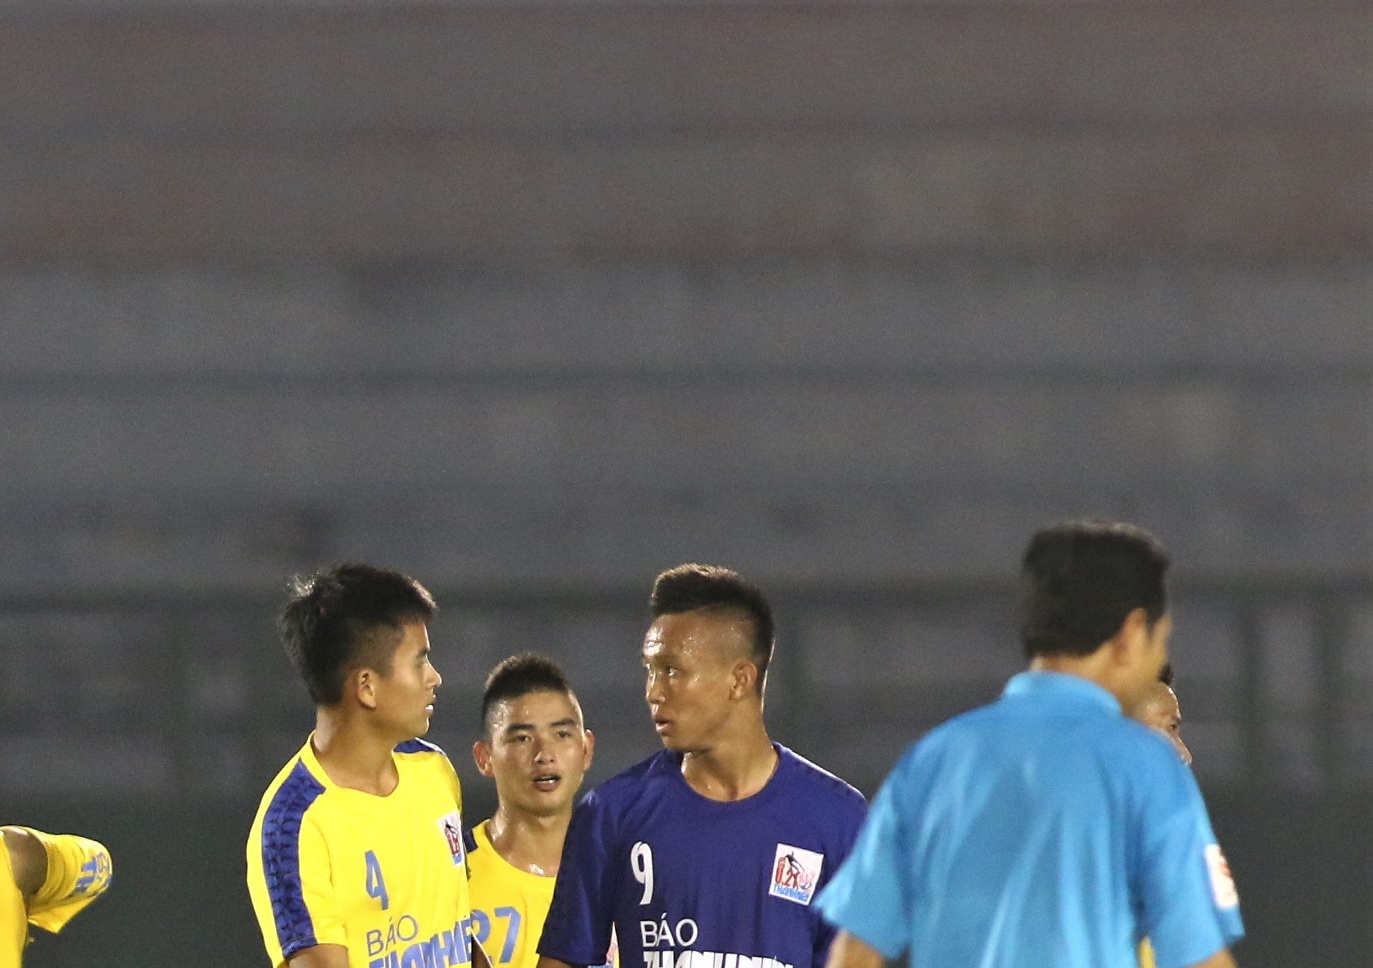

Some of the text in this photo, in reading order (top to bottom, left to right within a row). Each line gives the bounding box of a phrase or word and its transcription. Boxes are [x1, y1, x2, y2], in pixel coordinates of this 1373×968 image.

[364, 850, 389, 911] 4
[631, 842, 654, 906] 9
[366, 914, 419, 957] BÁO
[640, 913, 699, 948] BÁO
